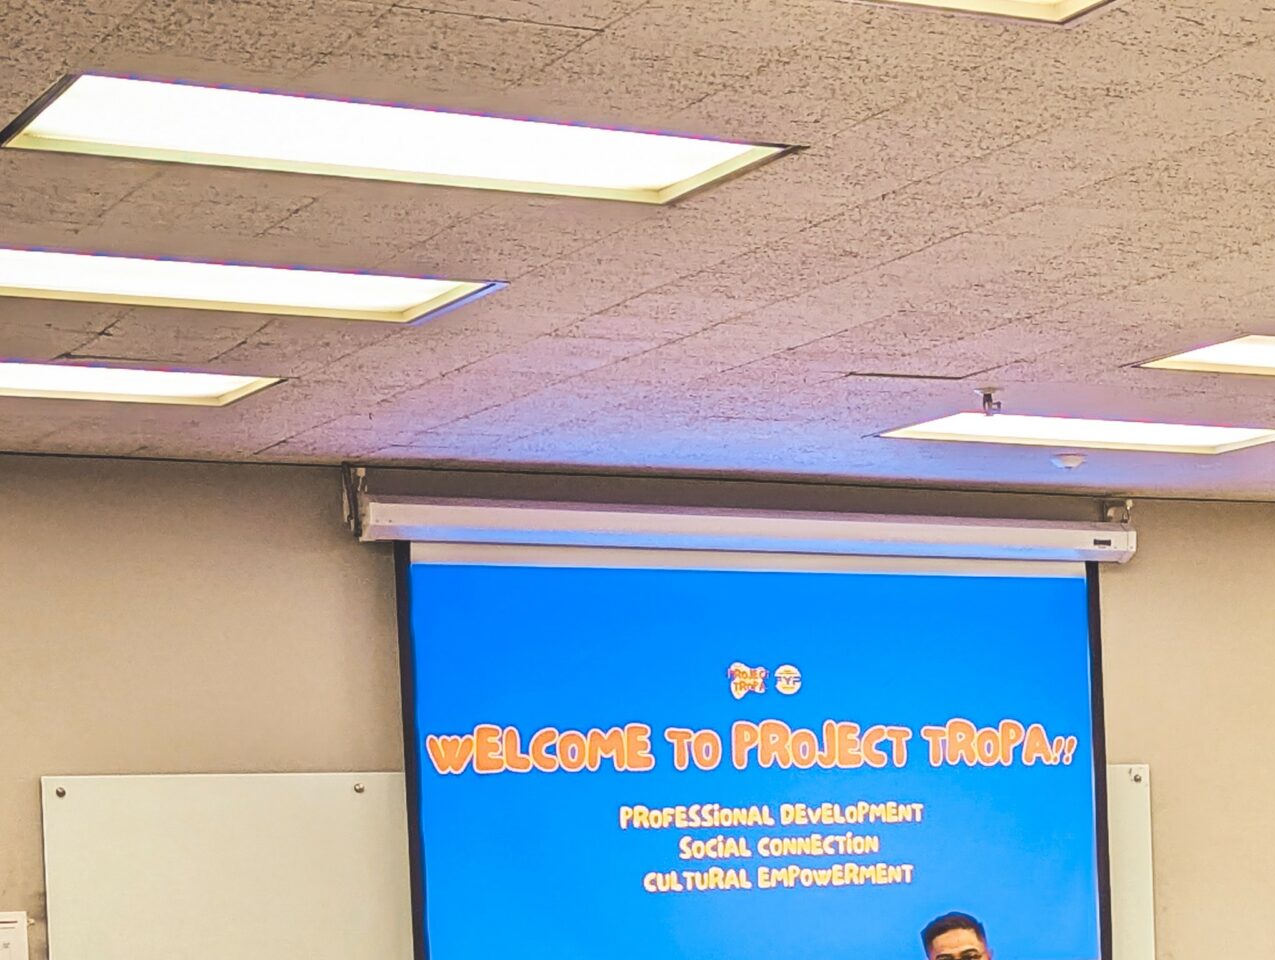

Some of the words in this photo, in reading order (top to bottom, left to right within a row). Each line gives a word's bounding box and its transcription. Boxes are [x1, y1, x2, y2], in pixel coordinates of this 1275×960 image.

[426, 723, 655, 774] WELCOME
[664, 727, 722, 771] TO
[731, 719, 911, 769] PROJECT
[920, 717, 1077, 767] TROPA!!
[619, 804, 775, 829] PROFESSIONAL
[780, 801, 924, 824] DEVELOPMENT
[679, 835, 752, 860] SOCIAL
[757, 831, 880, 857] CONNECTION
[643, 867, 753, 892] CULTURAL
[757, 863, 914, 888] EMPOWERMENT
